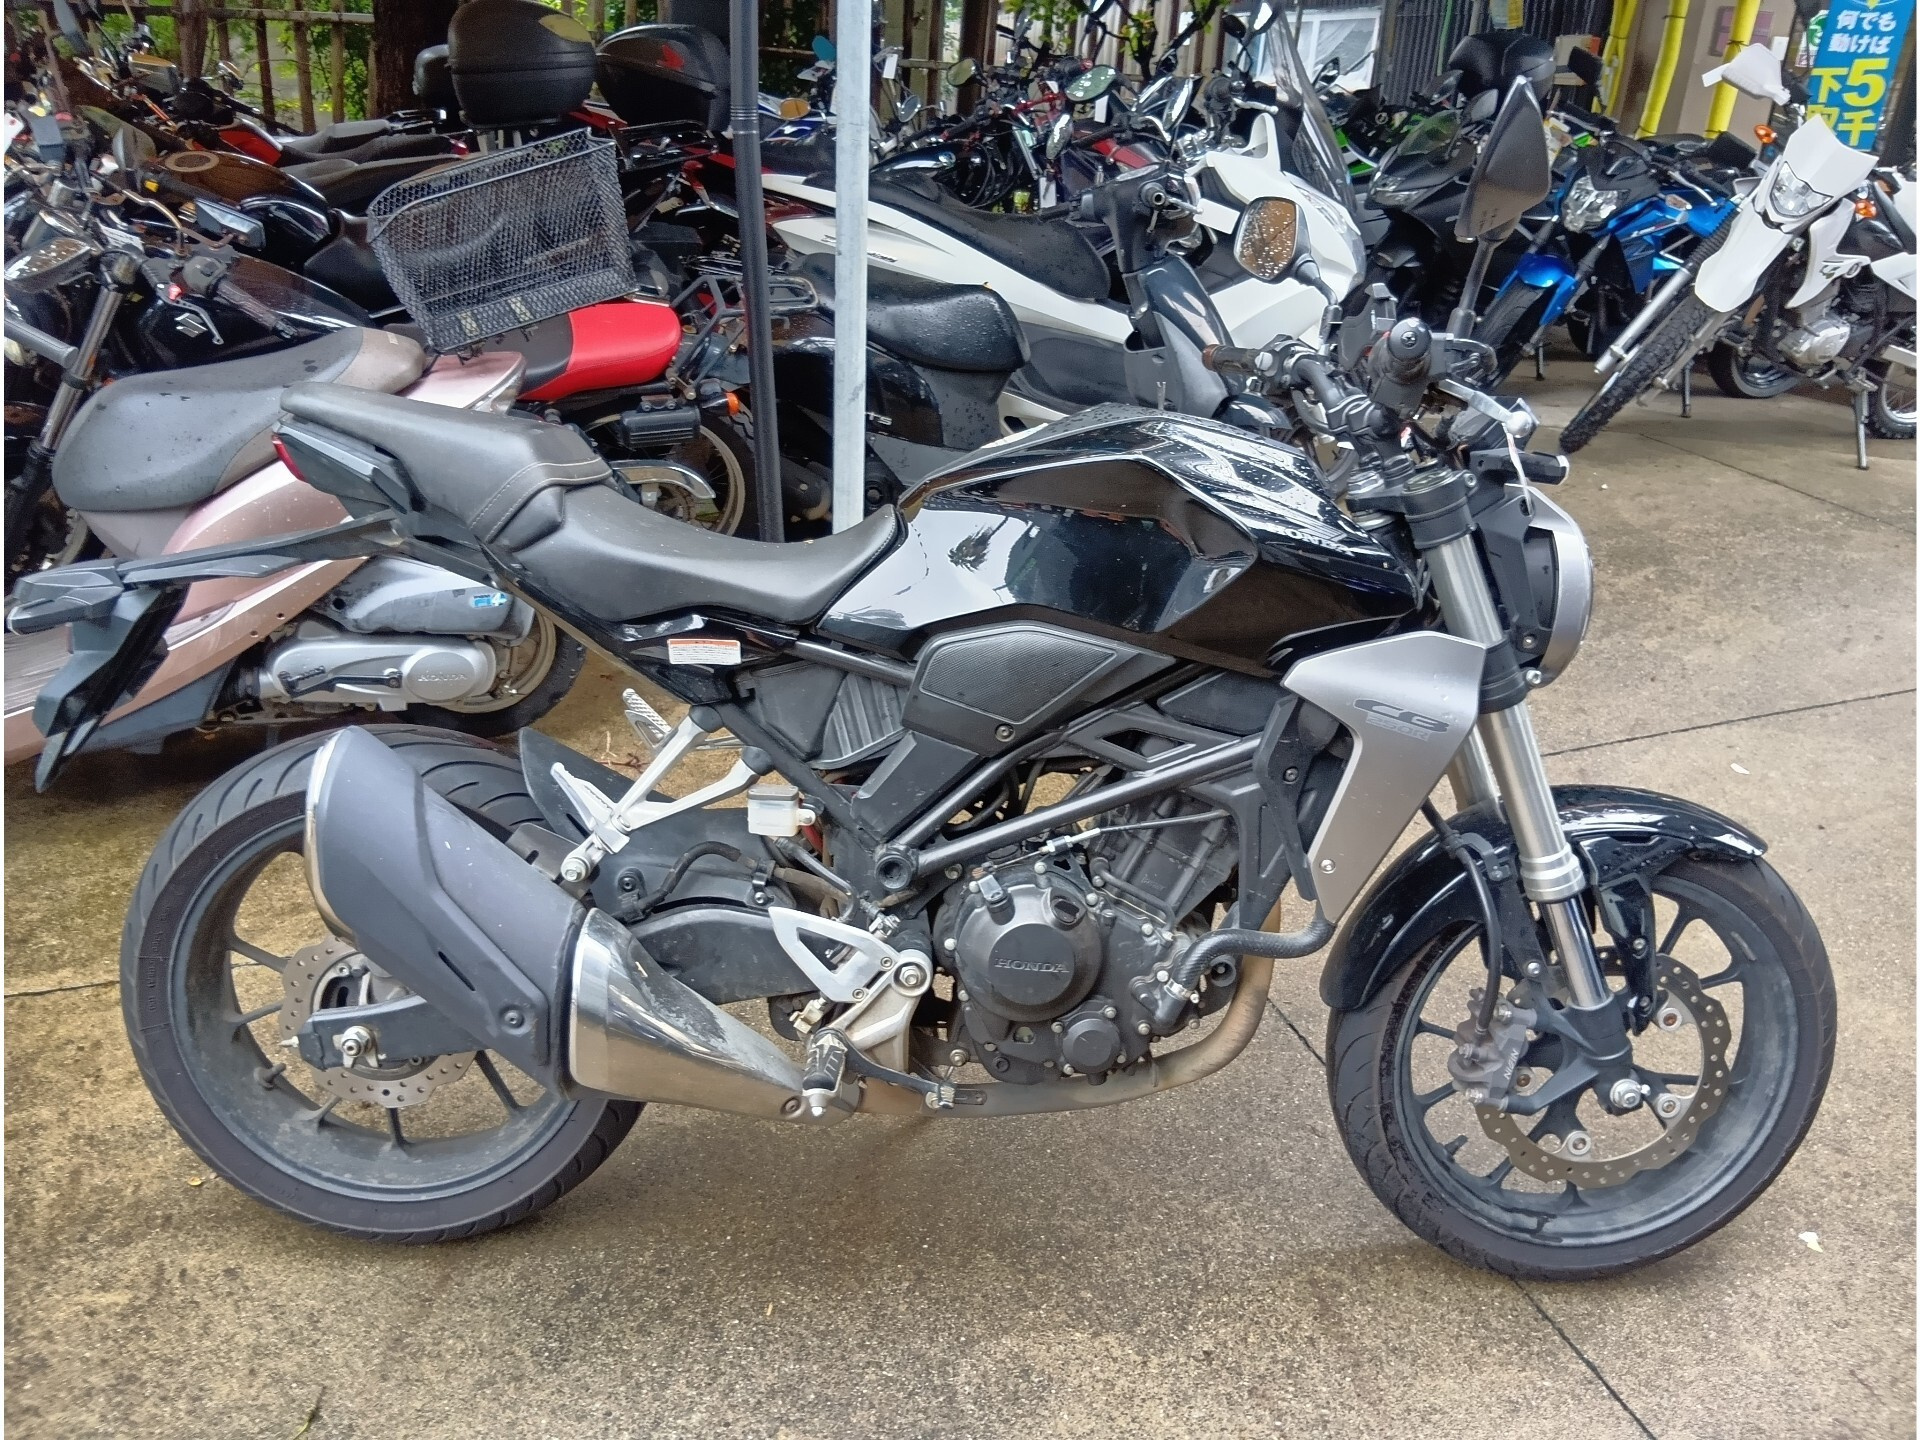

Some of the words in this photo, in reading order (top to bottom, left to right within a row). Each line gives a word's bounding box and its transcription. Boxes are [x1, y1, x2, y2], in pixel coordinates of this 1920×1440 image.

[1836, 10, 1897, 31] 何でも
[1828, 33, 1894, 54] 動けば
[1353, 698, 1450, 733] CB
[1365, 711, 1432, 741] 250R
[994, 958, 1070, 973] HONDA
